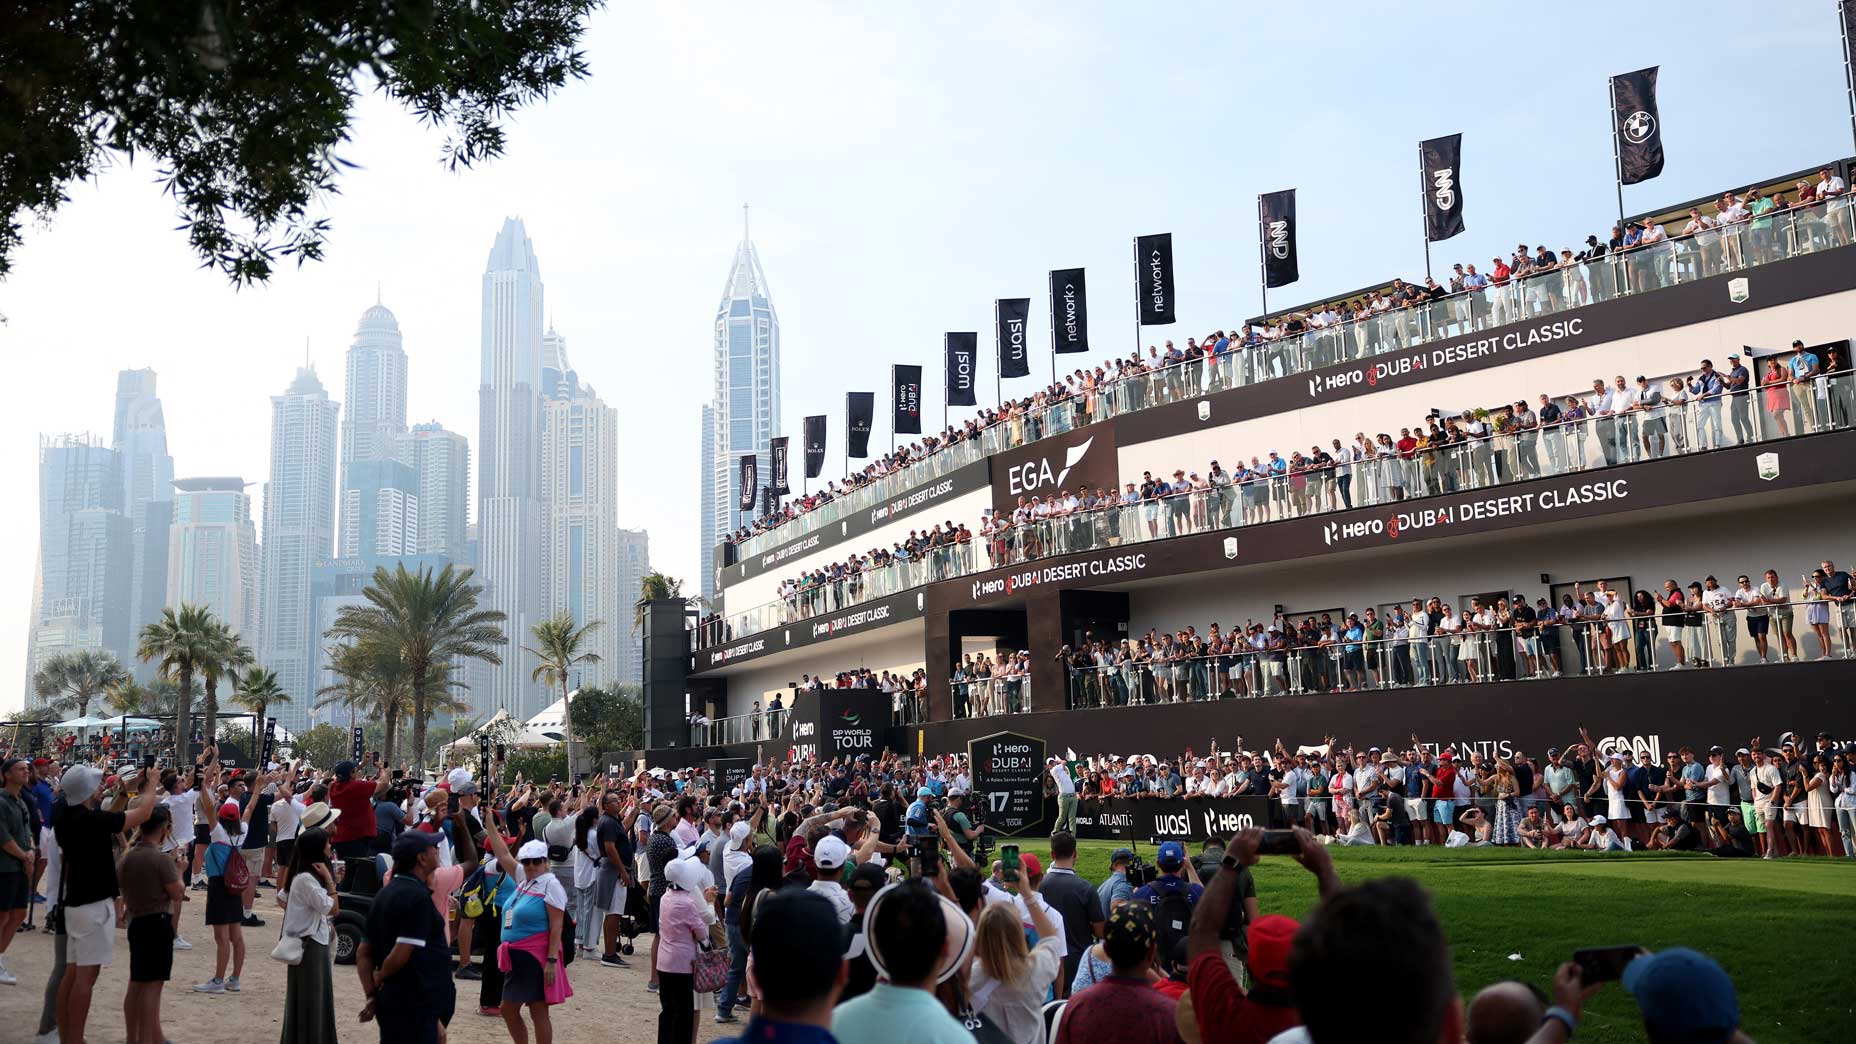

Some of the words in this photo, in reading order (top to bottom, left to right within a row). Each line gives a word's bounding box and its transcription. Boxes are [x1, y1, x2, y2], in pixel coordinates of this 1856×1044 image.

[1434, 168, 1455, 210] CNN
[1270, 220, 1289, 260] CNN
[1008, 318, 1023, 359] wasl
[1326, 370, 1363, 390] Hero
[1376, 353, 1427, 379] DUBAI
[1433, 337, 1500, 366] DESERT
[1503, 318, 1583, 350] CLASSIC
[955, 351, 970, 389] wasl
[1009, 457, 1055, 495] EGA
[877, 508, 889, 520] Hero
[892, 498, 907, 514] DUBAI
[908, 488, 928, 507] DESERT
[929, 479, 953, 499] CLASSIC
[1343, 519, 1383, 538] Hero
[1397, 507, 1454, 531] DUBAI
[1460, 494, 1534, 521] DESERT
[1539, 479, 1628, 509] CLASSIC
[789, 541, 802, 556] DESERT
[803, 534, 819, 550] CLASSIC
[982, 578, 1004, 594] Hero
[1011, 570, 1041, 589] DUBAI
[1043, 562, 1088, 583] DESERT
[1089, 554, 1146, 575] CLASSIC
[818, 622, 829, 634] Hero
[832, 617, 847, 631] DUBAI
[847, 611, 867, 627] DESERT
[867, 605, 890, 622] CLASSIC
[736, 643, 748, 656] DESERT
[749, 640, 764, 653] CLASSIC
[800, 722, 814, 736] Hero
[833, 736, 872, 750] TOUR
[992, 757, 1031, 769] DUBAI
[1004, 745, 1029, 753] Hero
[1597, 735, 1661, 769] CNN
[988, 791, 1009, 812] 17
[1076, 817, 1093, 825] WORLD
[1155, 809, 1191, 835] wasl
[1218, 814, 1253, 832] Hero
